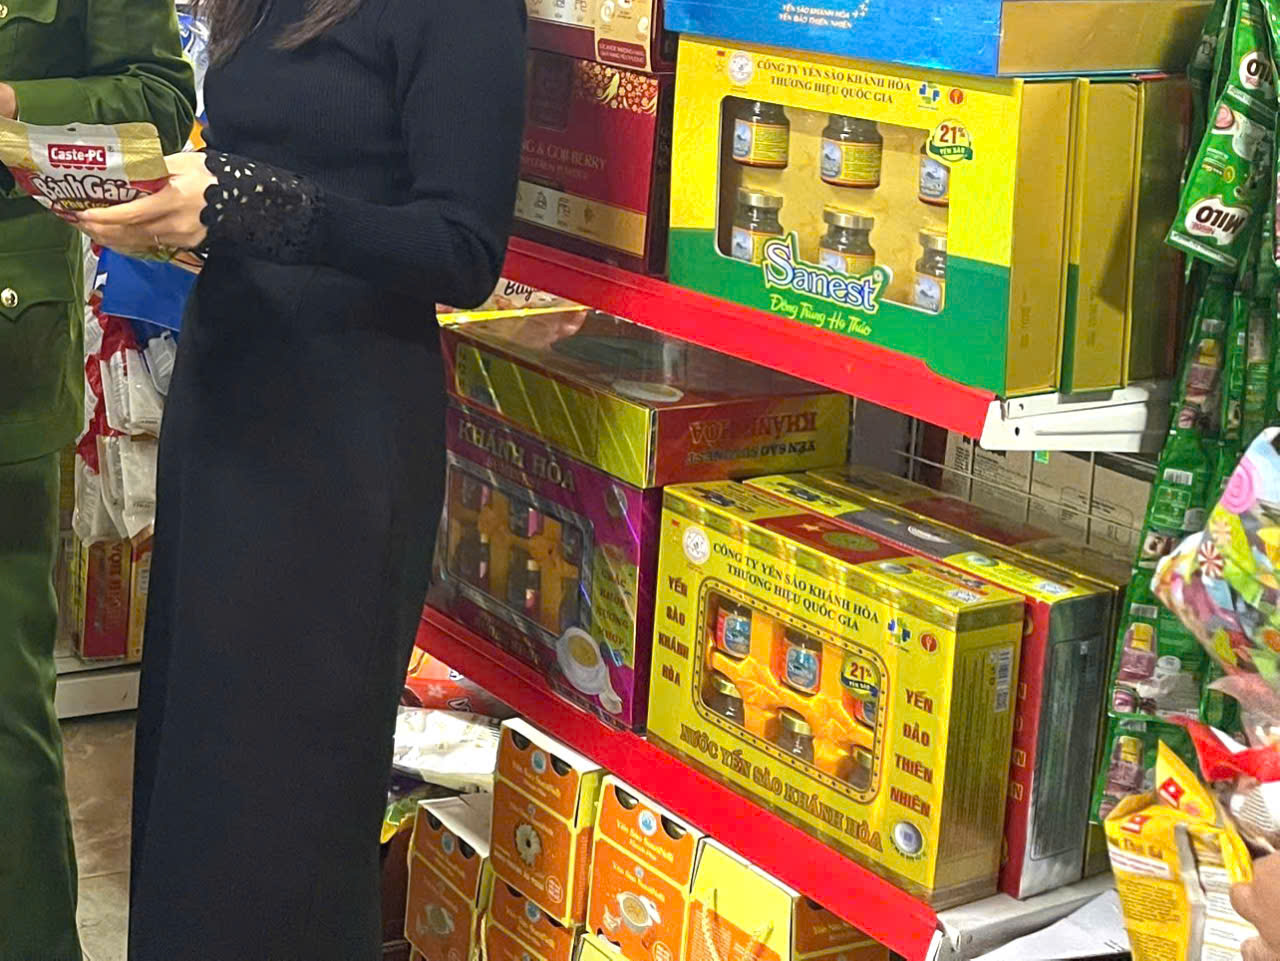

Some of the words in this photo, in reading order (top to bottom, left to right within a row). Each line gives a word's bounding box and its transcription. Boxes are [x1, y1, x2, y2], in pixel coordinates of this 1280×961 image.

[757, 58, 786, 74] CÔNG
[786, 62, 801, 76] TY
[846, 69, 886, 87] KHÁNH
[872, 90, 894, 105] GIA
[50, 147, 105, 162] Caste-PC
[766, 242, 876, 312] Sanest
[713, 541, 743, 564] CÔNG
[744, 555, 758, 571] TY
[808, 580, 852, 614] KHÁNH
[837, 612, 861, 632] GIA
[905, 686, 934, 715] YẾN
[895, 751, 934, 785] THIÊN
[783, 780, 844, 832] KHÁNH
[890, 785, 932, 819] NHIÊN
